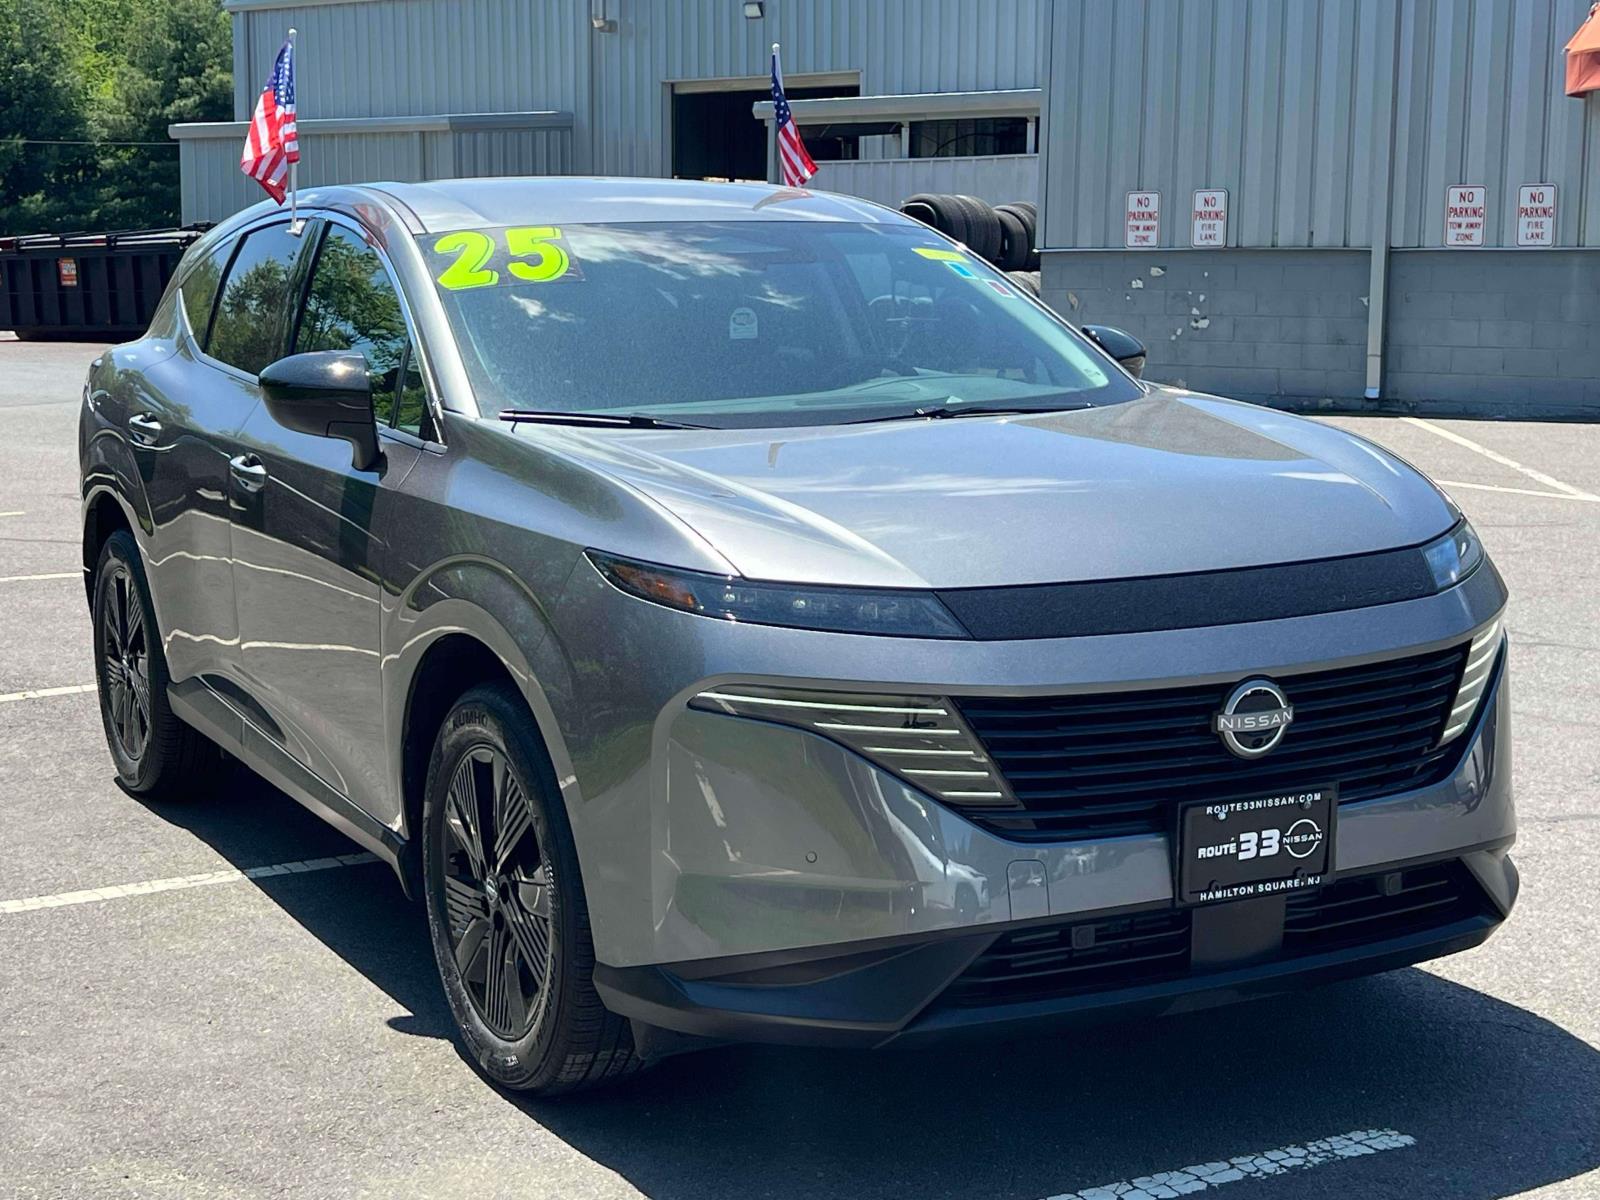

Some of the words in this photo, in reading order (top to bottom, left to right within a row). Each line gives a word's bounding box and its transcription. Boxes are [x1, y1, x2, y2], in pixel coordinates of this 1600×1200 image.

[1137, 197, 1150, 208] NO
[1203, 196, 1216, 207] NO
[1459, 192, 1474, 203] NO
[1530, 192, 1544, 203] NO
[1128, 211, 1158, 222] PARKING
[1194, 210, 1224, 221] PARKING
[1448, 206, 1484, 218] PARKING
[1519, 206, 1553, 218] PARKING
[1129, 224, 1140, 232] TOW
[1201, 223, 1217, 231] FIRE
[1448, 221, 1462, 230] TOW
[1465, 221, 1482, 230] AWAY
[1527, 221, 1544, 230] FIRE
[1200, 233, 1217, 241] LANE
[1455, 233, 1474, 242] ZONE
[1525, 232, 1545, 240] LANE
[434, 226, 570, 291] 25
[1220, 710, 1293, 729] NISSAN
[1206, 792, 1322, 814] ROUTE33NISSAN.COM
[1197, 842, 1237, 859] ROUTE
[1238, 828, 1281, 861] 33
[1283, 832, 1323, 844] NISSAN
[1200, 885, 1254, 902] HAMILTON
[1258, 878, 1304, 893] SQUARE,
[1307, 876, 1321, 885] NJ
